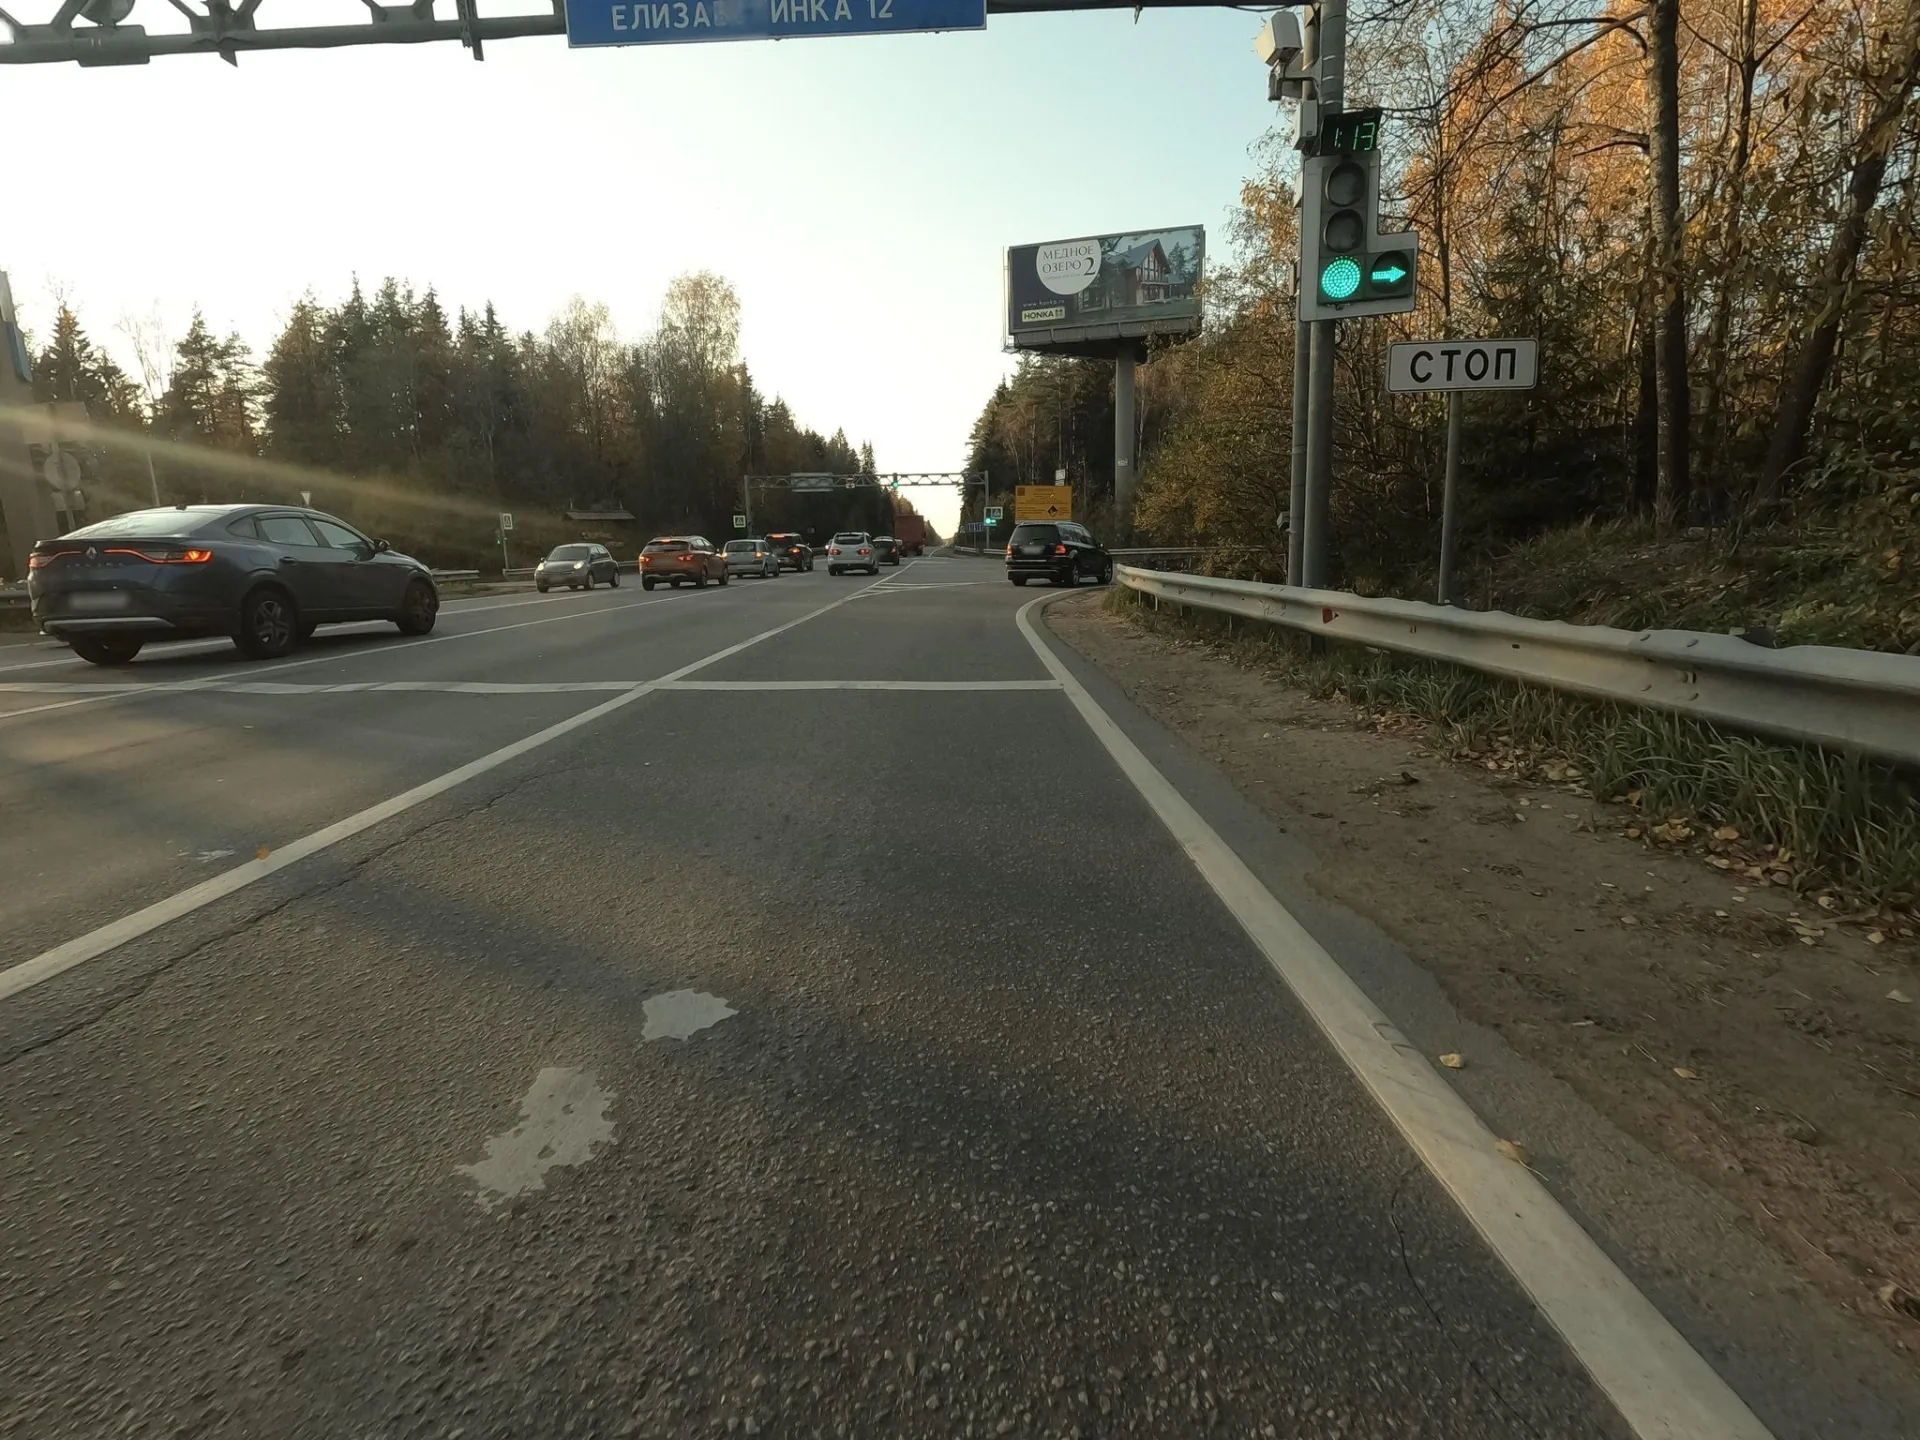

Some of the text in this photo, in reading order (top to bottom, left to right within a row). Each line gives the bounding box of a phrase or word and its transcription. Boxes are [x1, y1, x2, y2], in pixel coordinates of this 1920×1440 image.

[868, 0, 894, 19] 12
[1044, 245, 1095, 260] МЕДНОЕ
[1043, 257, 1096, 276] ОЗЕРО 2
[1023, 310, 1054, 320] HONKA
[1410, 348, 1517, 384] СТОП
